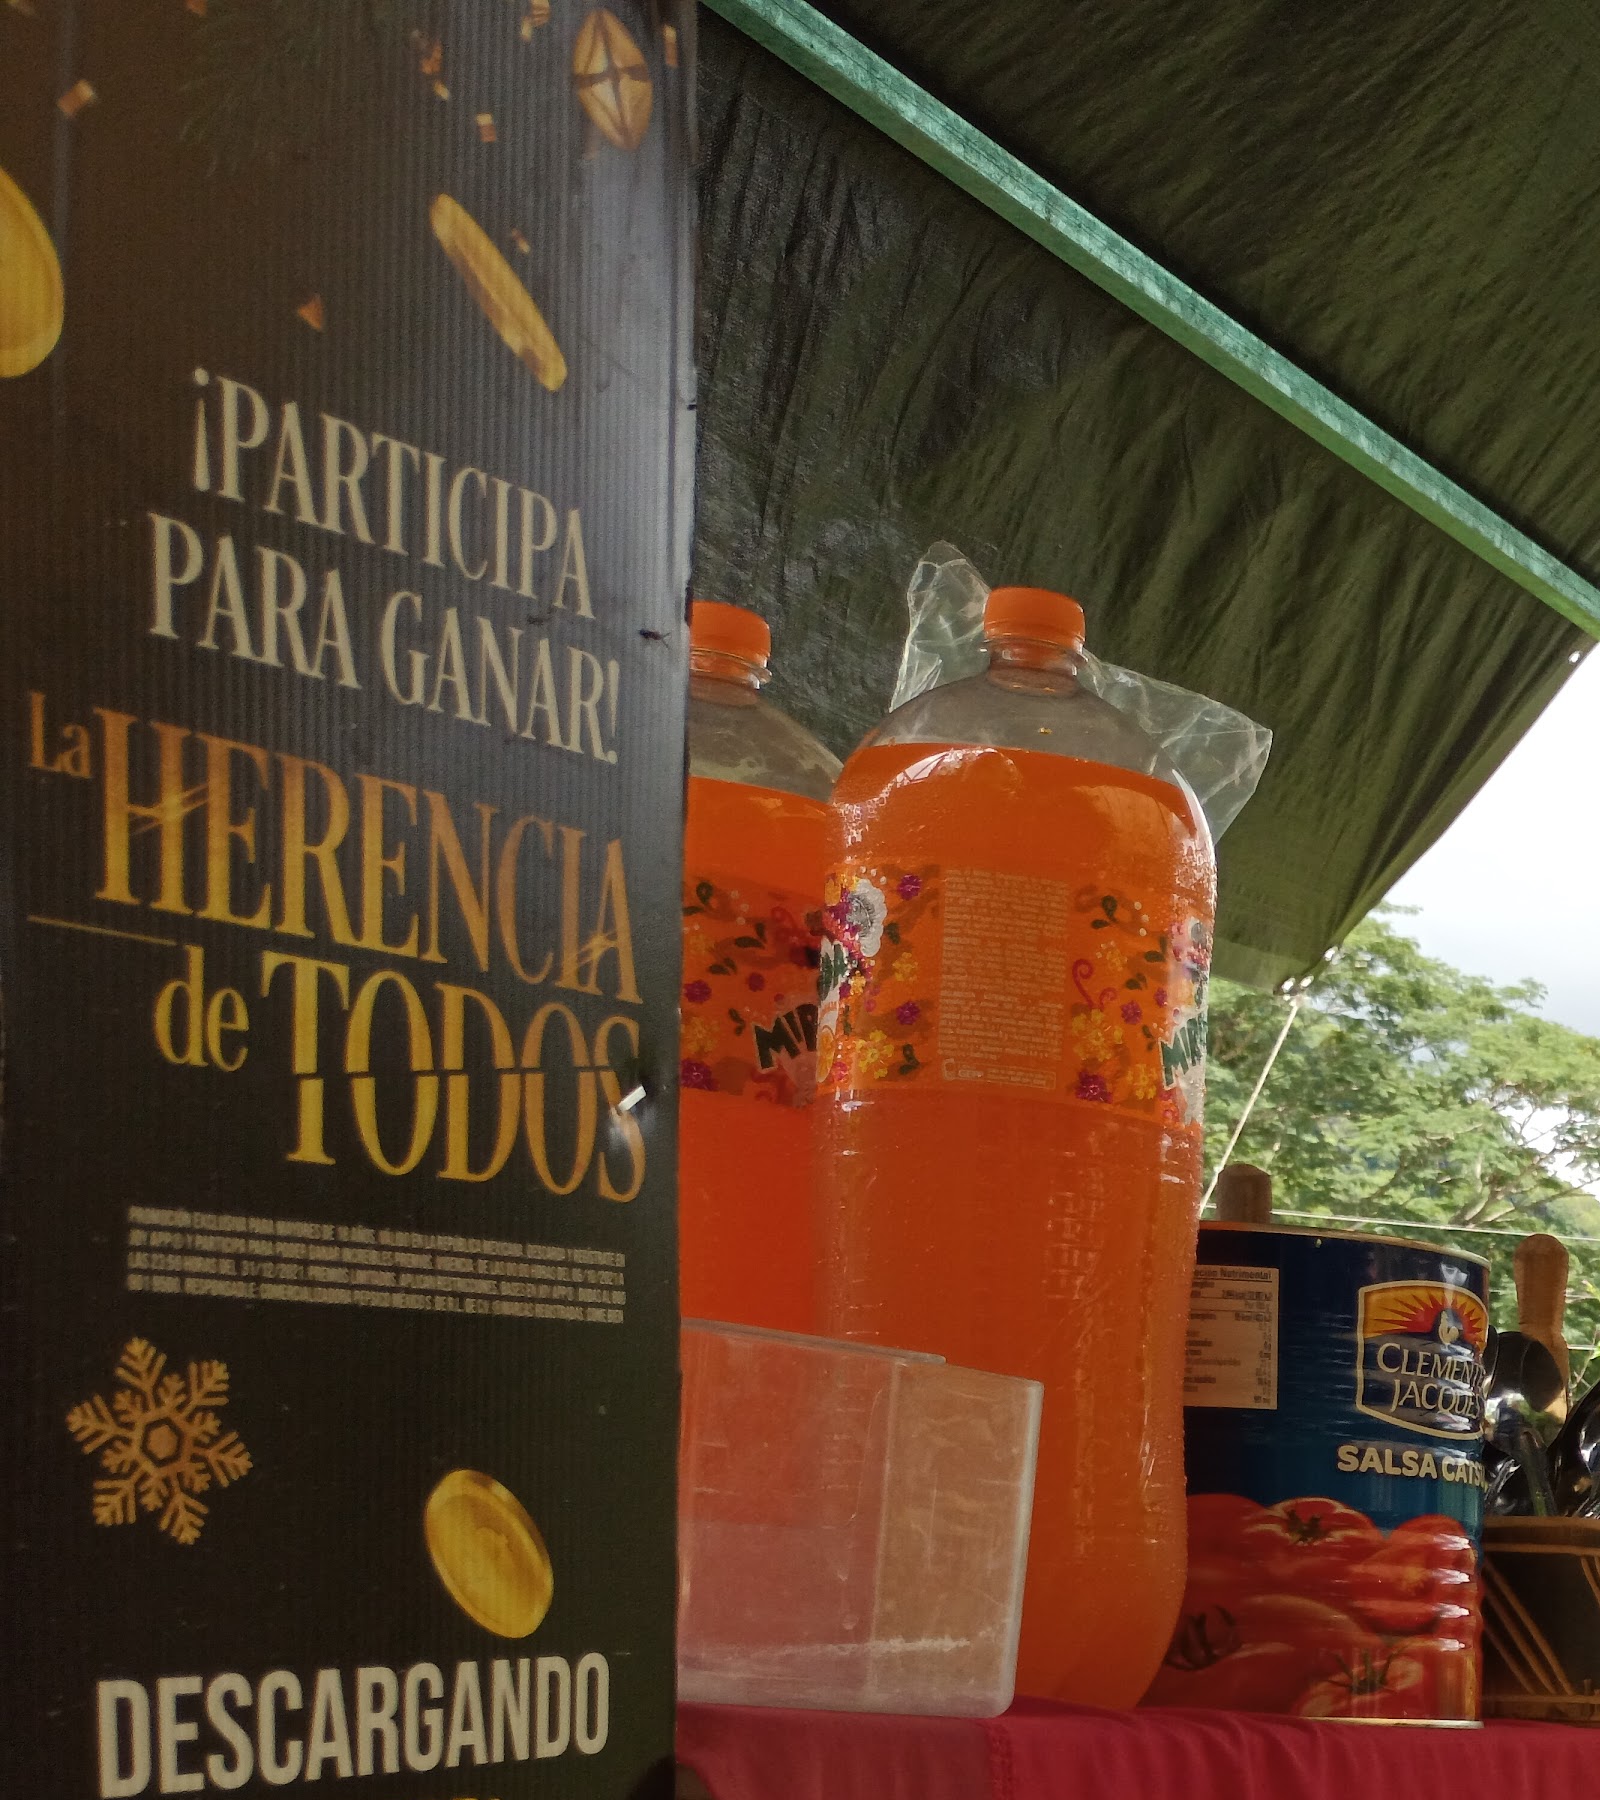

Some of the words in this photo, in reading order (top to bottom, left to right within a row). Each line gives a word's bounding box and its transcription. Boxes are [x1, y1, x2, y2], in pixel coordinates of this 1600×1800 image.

[193, 368, 596, 619] ¡PARTICIPA
[147, 512, 362, 690] PARA
[380, 589, 621, 764] GANAR!
[28, 691, 92, 780] La
[93, 708, 645, 1004] HERENCIA
[154, 944, 251, 1072] de
[261, 952, 647, 1203] TODOS
[1337, 1444, 1438, 1479] SALSA
[1390, 1379, 1480, 1419] JACQUES
[97, 1652, 610, 1800] DESCARGANDO
